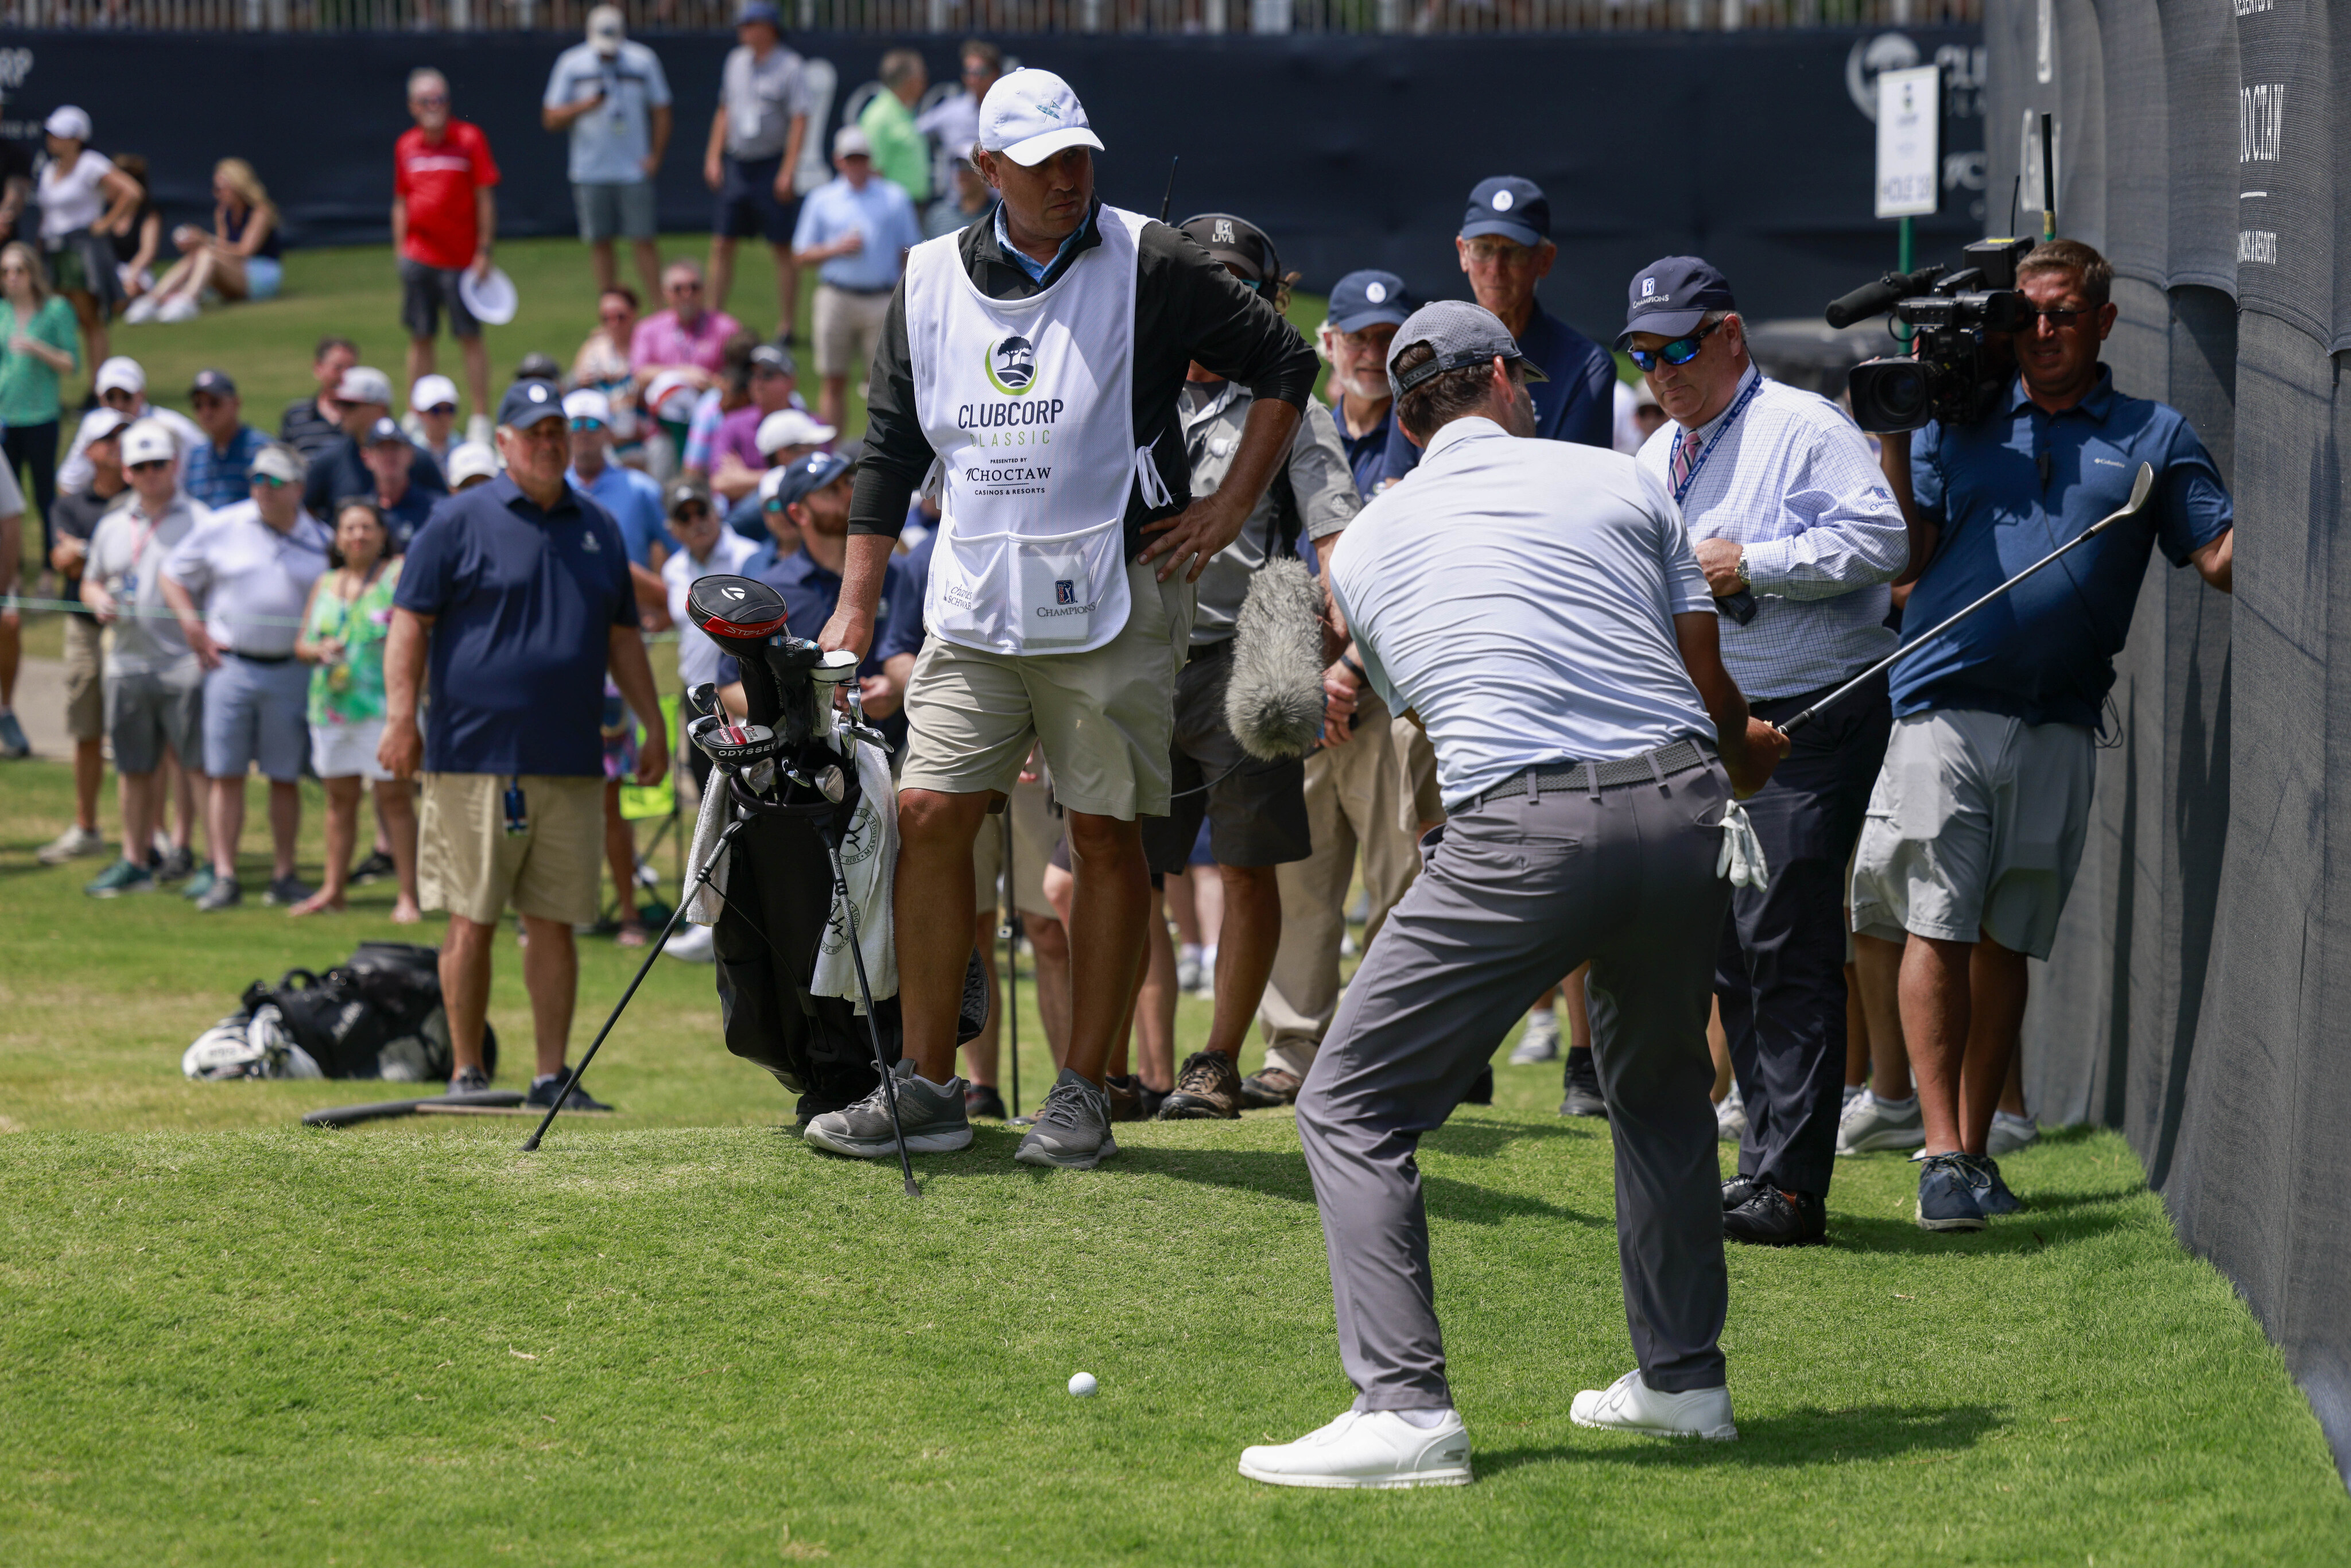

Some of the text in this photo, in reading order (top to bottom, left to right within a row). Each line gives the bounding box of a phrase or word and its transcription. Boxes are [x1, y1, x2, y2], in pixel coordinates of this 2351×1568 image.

[2240, 84, 2284, 163] OCTAW
[2237, 230, 2251, 263] INOS
[1633, 294, 1670, 309] CHAMPIONS
[958, 399, 1064, 429] CLUBCORP
[969, 429, 1050, 448] CLASSIC
[971, 467, 1052, 482] CHOCTAW
[947, 595, 972, 610] SCHWAB
[1037, 602, 1096, 618] CHAMPIONS
[717, 728, 733, 745] ODYSS
[718, 742, 776, 757] ODYSSEY
